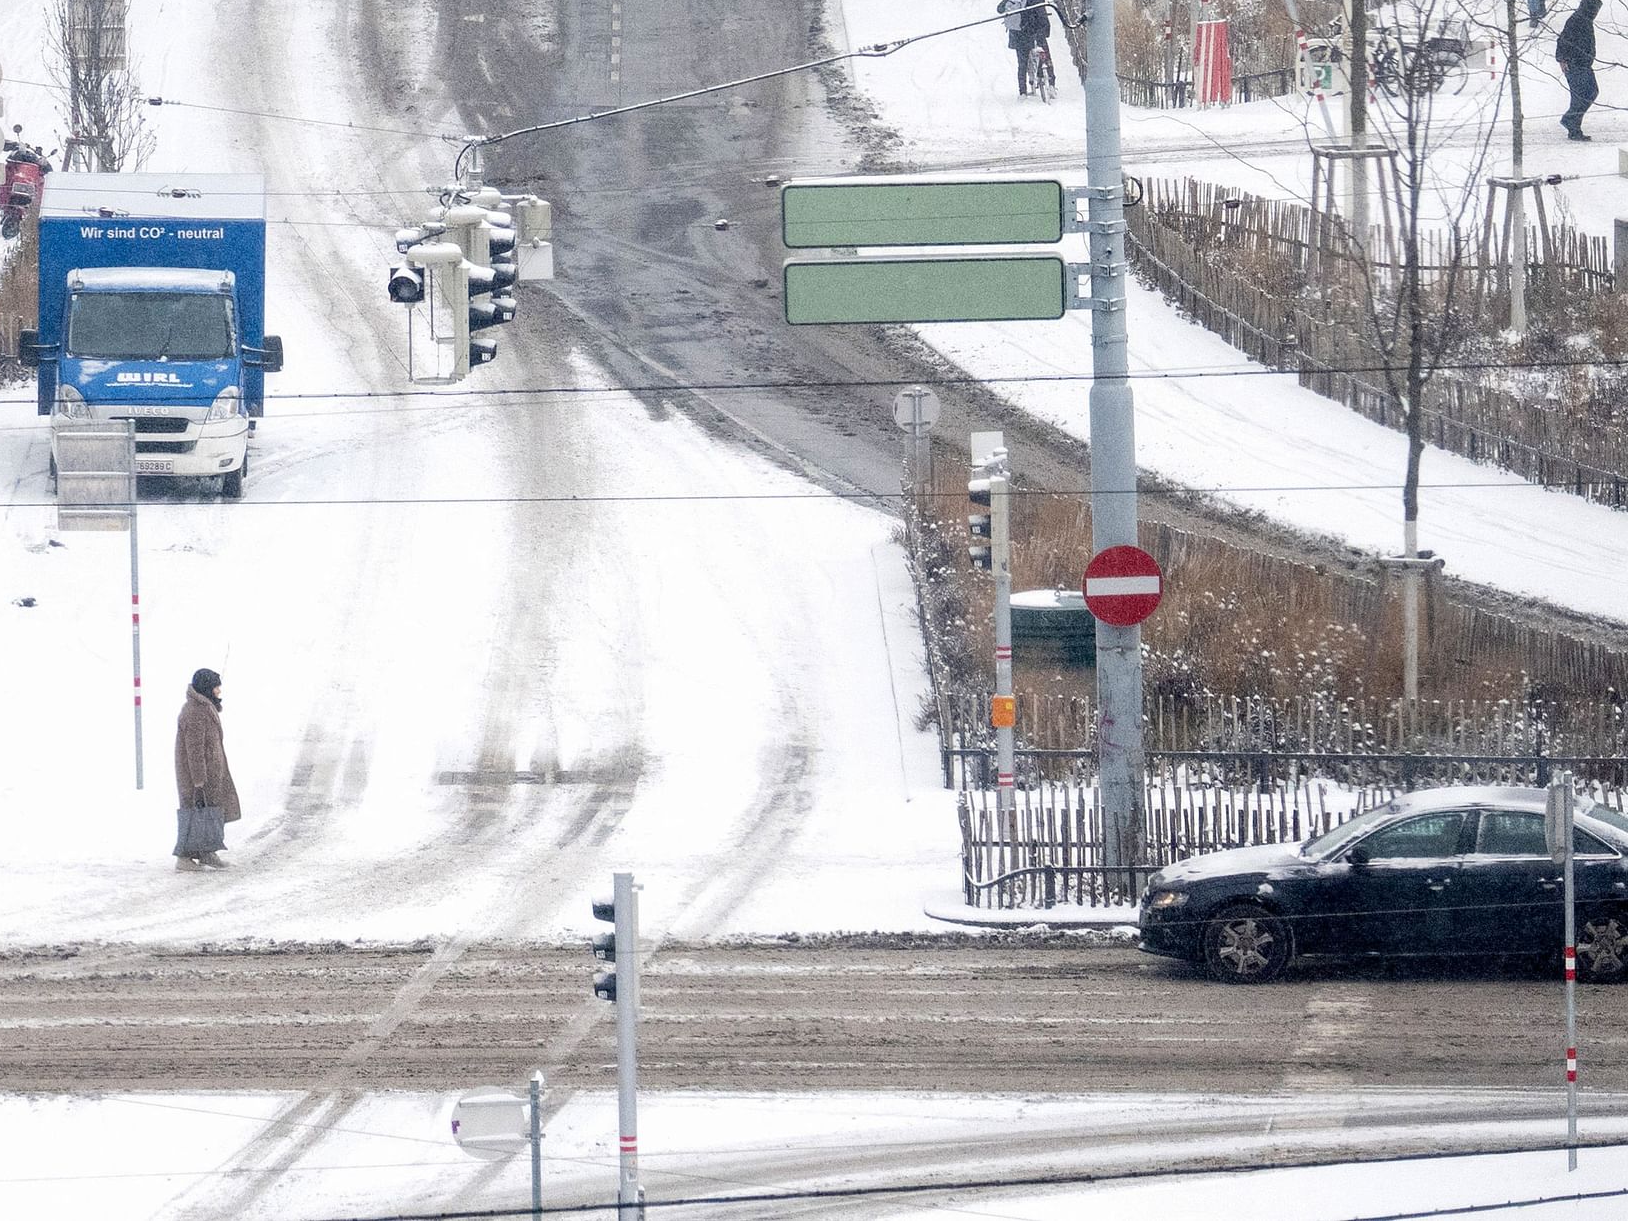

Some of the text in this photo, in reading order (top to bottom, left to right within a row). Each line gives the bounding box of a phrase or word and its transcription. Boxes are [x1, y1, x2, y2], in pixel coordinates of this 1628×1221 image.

[80, 226, 103, 239] Wir
[107, 226, 135, 239] sind
[177, 227, 224, 240] neutral
[116, 372, 181, 383] WIRL
[128, 406, 170, 416] IVECO
